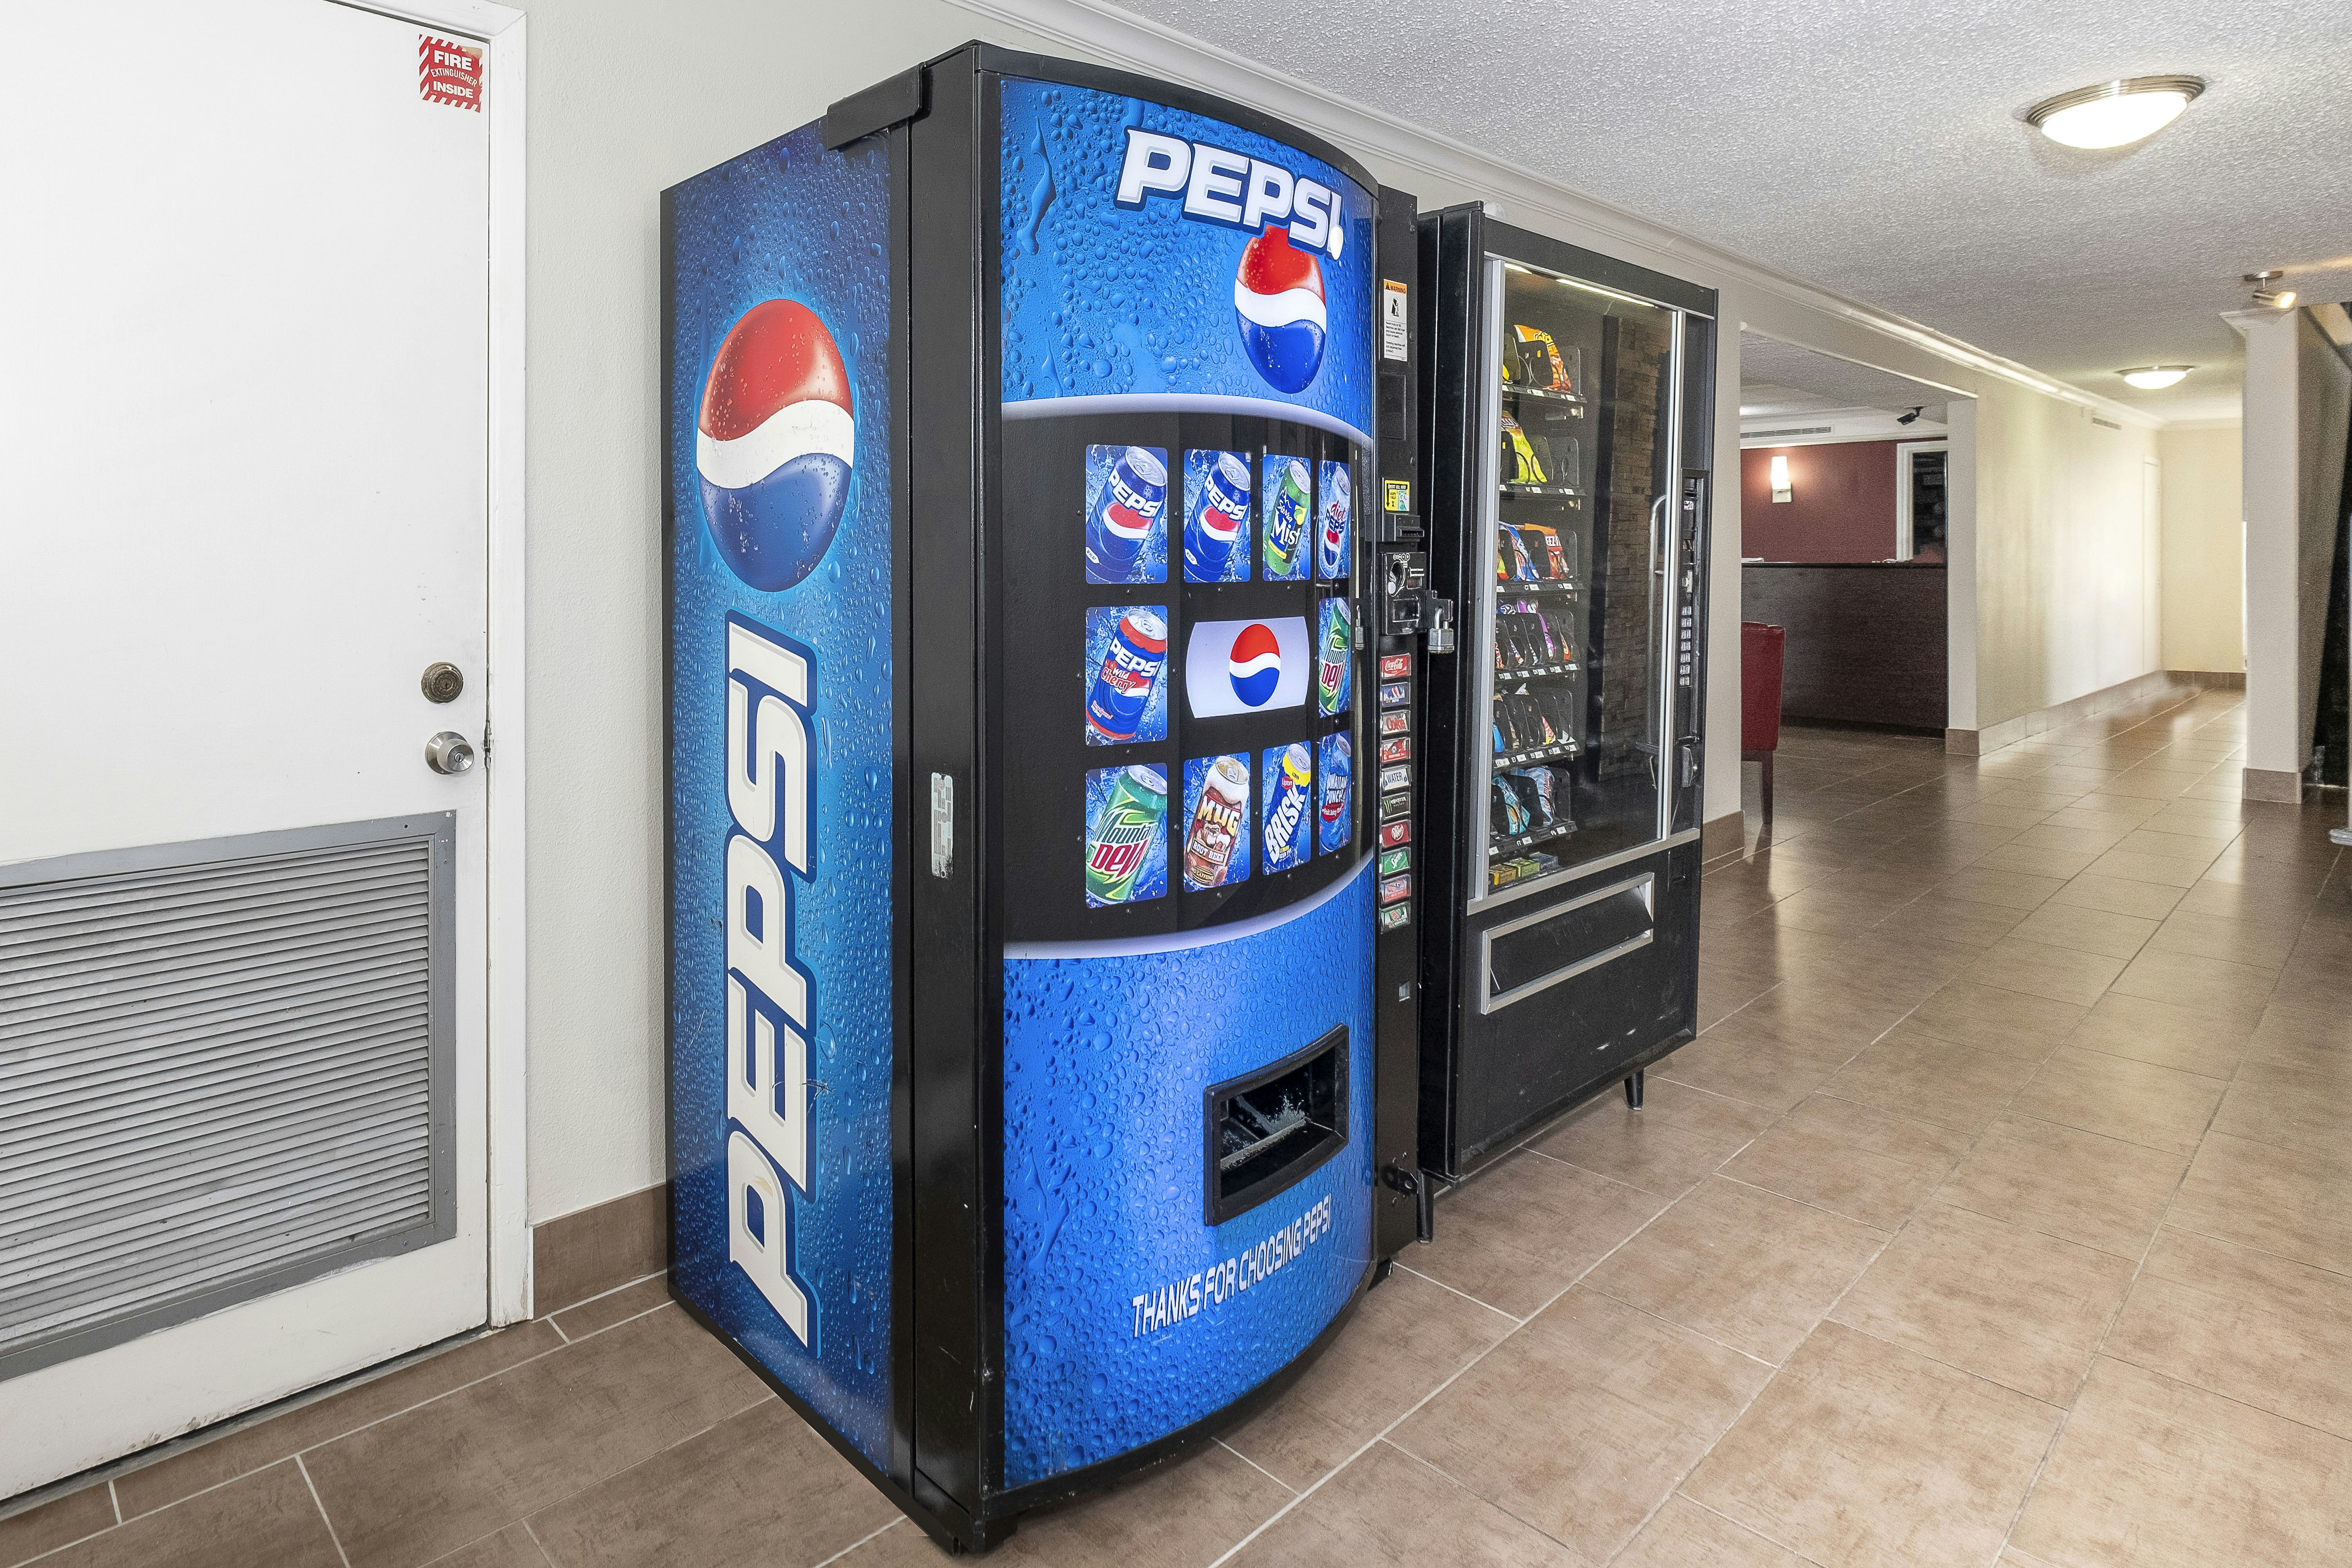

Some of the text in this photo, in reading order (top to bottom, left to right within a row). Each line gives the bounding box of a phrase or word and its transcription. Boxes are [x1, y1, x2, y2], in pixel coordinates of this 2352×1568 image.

[434, 49, 473, 71] FIRE
[430, 67, 477, 87] EXTINGUISHER
[433, 80, 474, 99] INSIDE
[1116, 128, 1343, 252] PEPSI
[1108, 466, 1163, 517] PEPSI
[1204, 472, 1249, 520] PEPSI
[1270, 507, 1301, 545] Mist
[1330, 499, 1347, 522] diet
[1110, 636, 1161, 677] PEPSI
[1112, 667, 1131, 679] Wild
[1101, 666, 1136, 694] Cherry
[1386, 717, 1406, 731] Coke
[1386, 771, 1403, 784] WATER
[1197, 795, 1241, 837] MUG
[1265, 781, 1306, 864] BRISK
[1193, 841, 1224, 862] ROOT BEER
[728, 621, 811, 1348] PEPSI
[1132, 1193, 1331, 1338] THANKS FOR CHOOSING PEPSI
